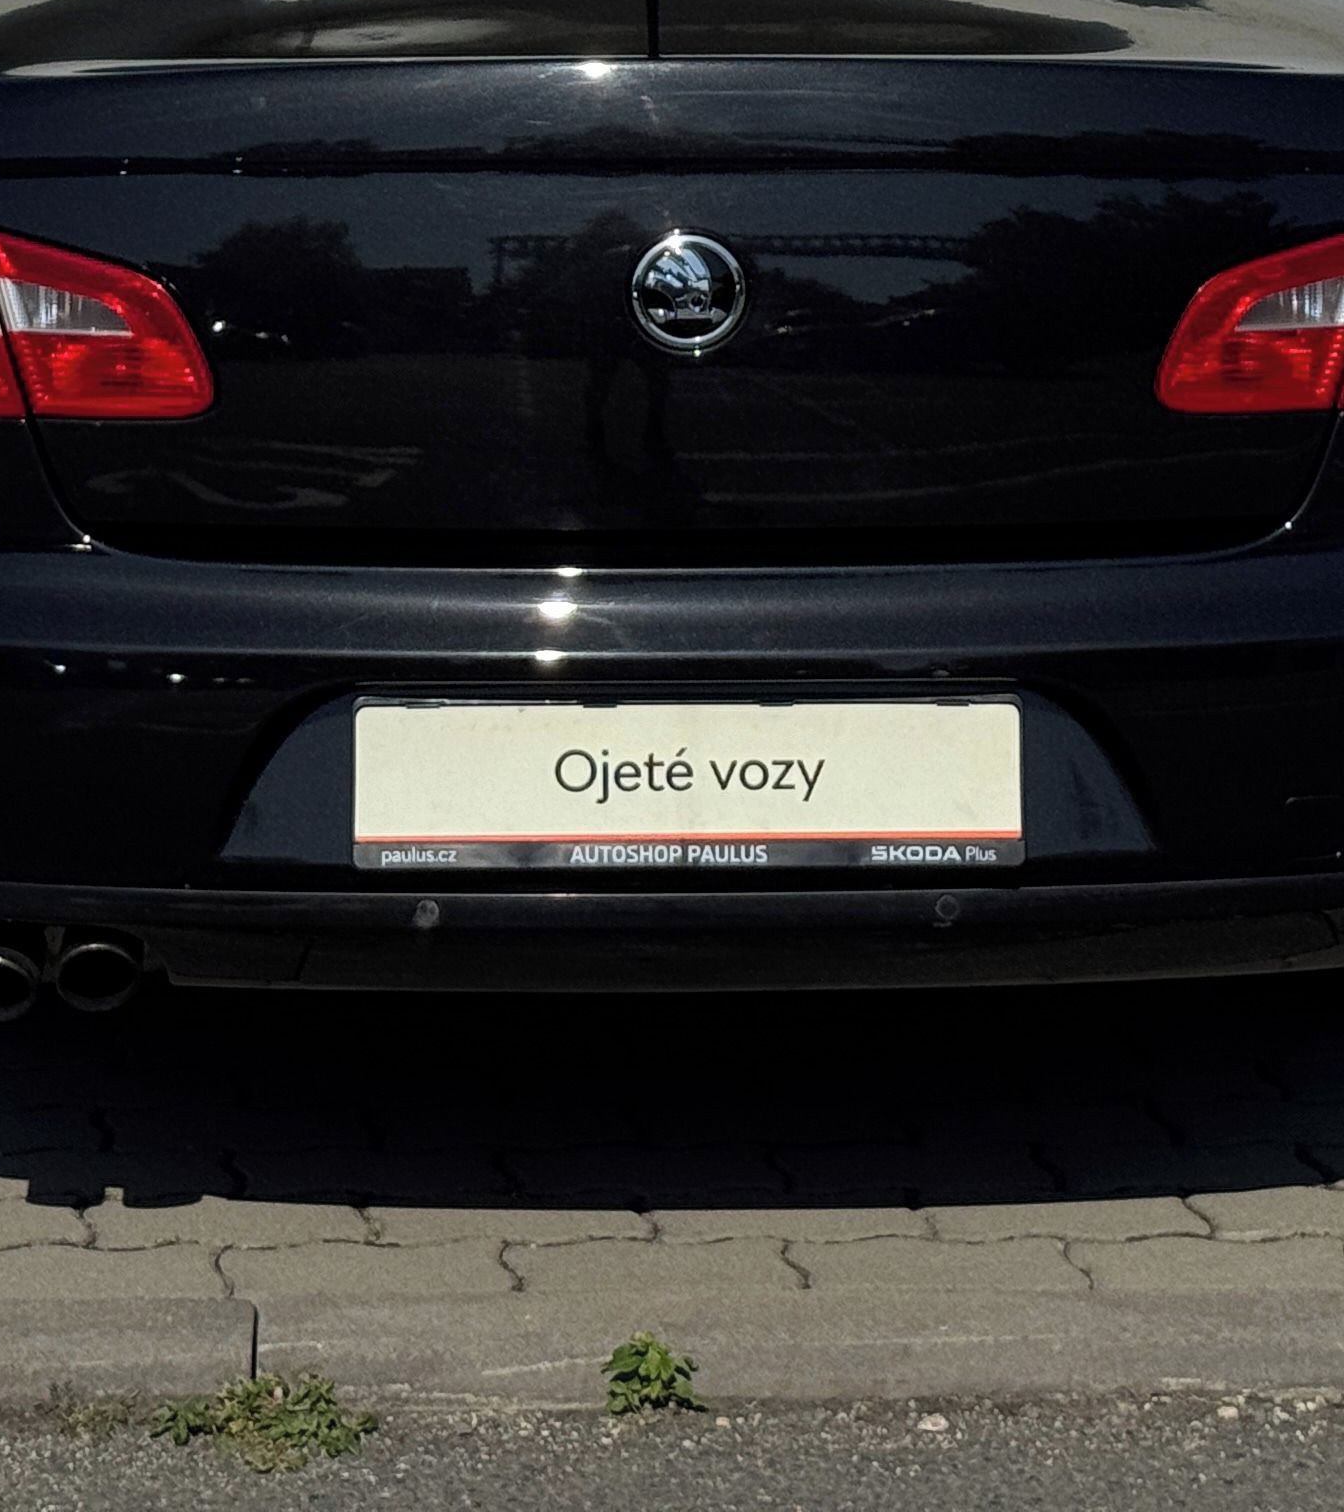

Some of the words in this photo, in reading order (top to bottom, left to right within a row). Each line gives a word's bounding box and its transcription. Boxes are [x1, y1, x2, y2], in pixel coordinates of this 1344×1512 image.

[555, 747, 694, 804] Ojeté
[709, 759, 825, 802] vozy
[381, 846, 457, 866] paulus.cz
[570, 844, 682, 864] AUTOSHOP
[687, 844, 768, 864] PAULUS
[965, 845, 997, 861] Plus
